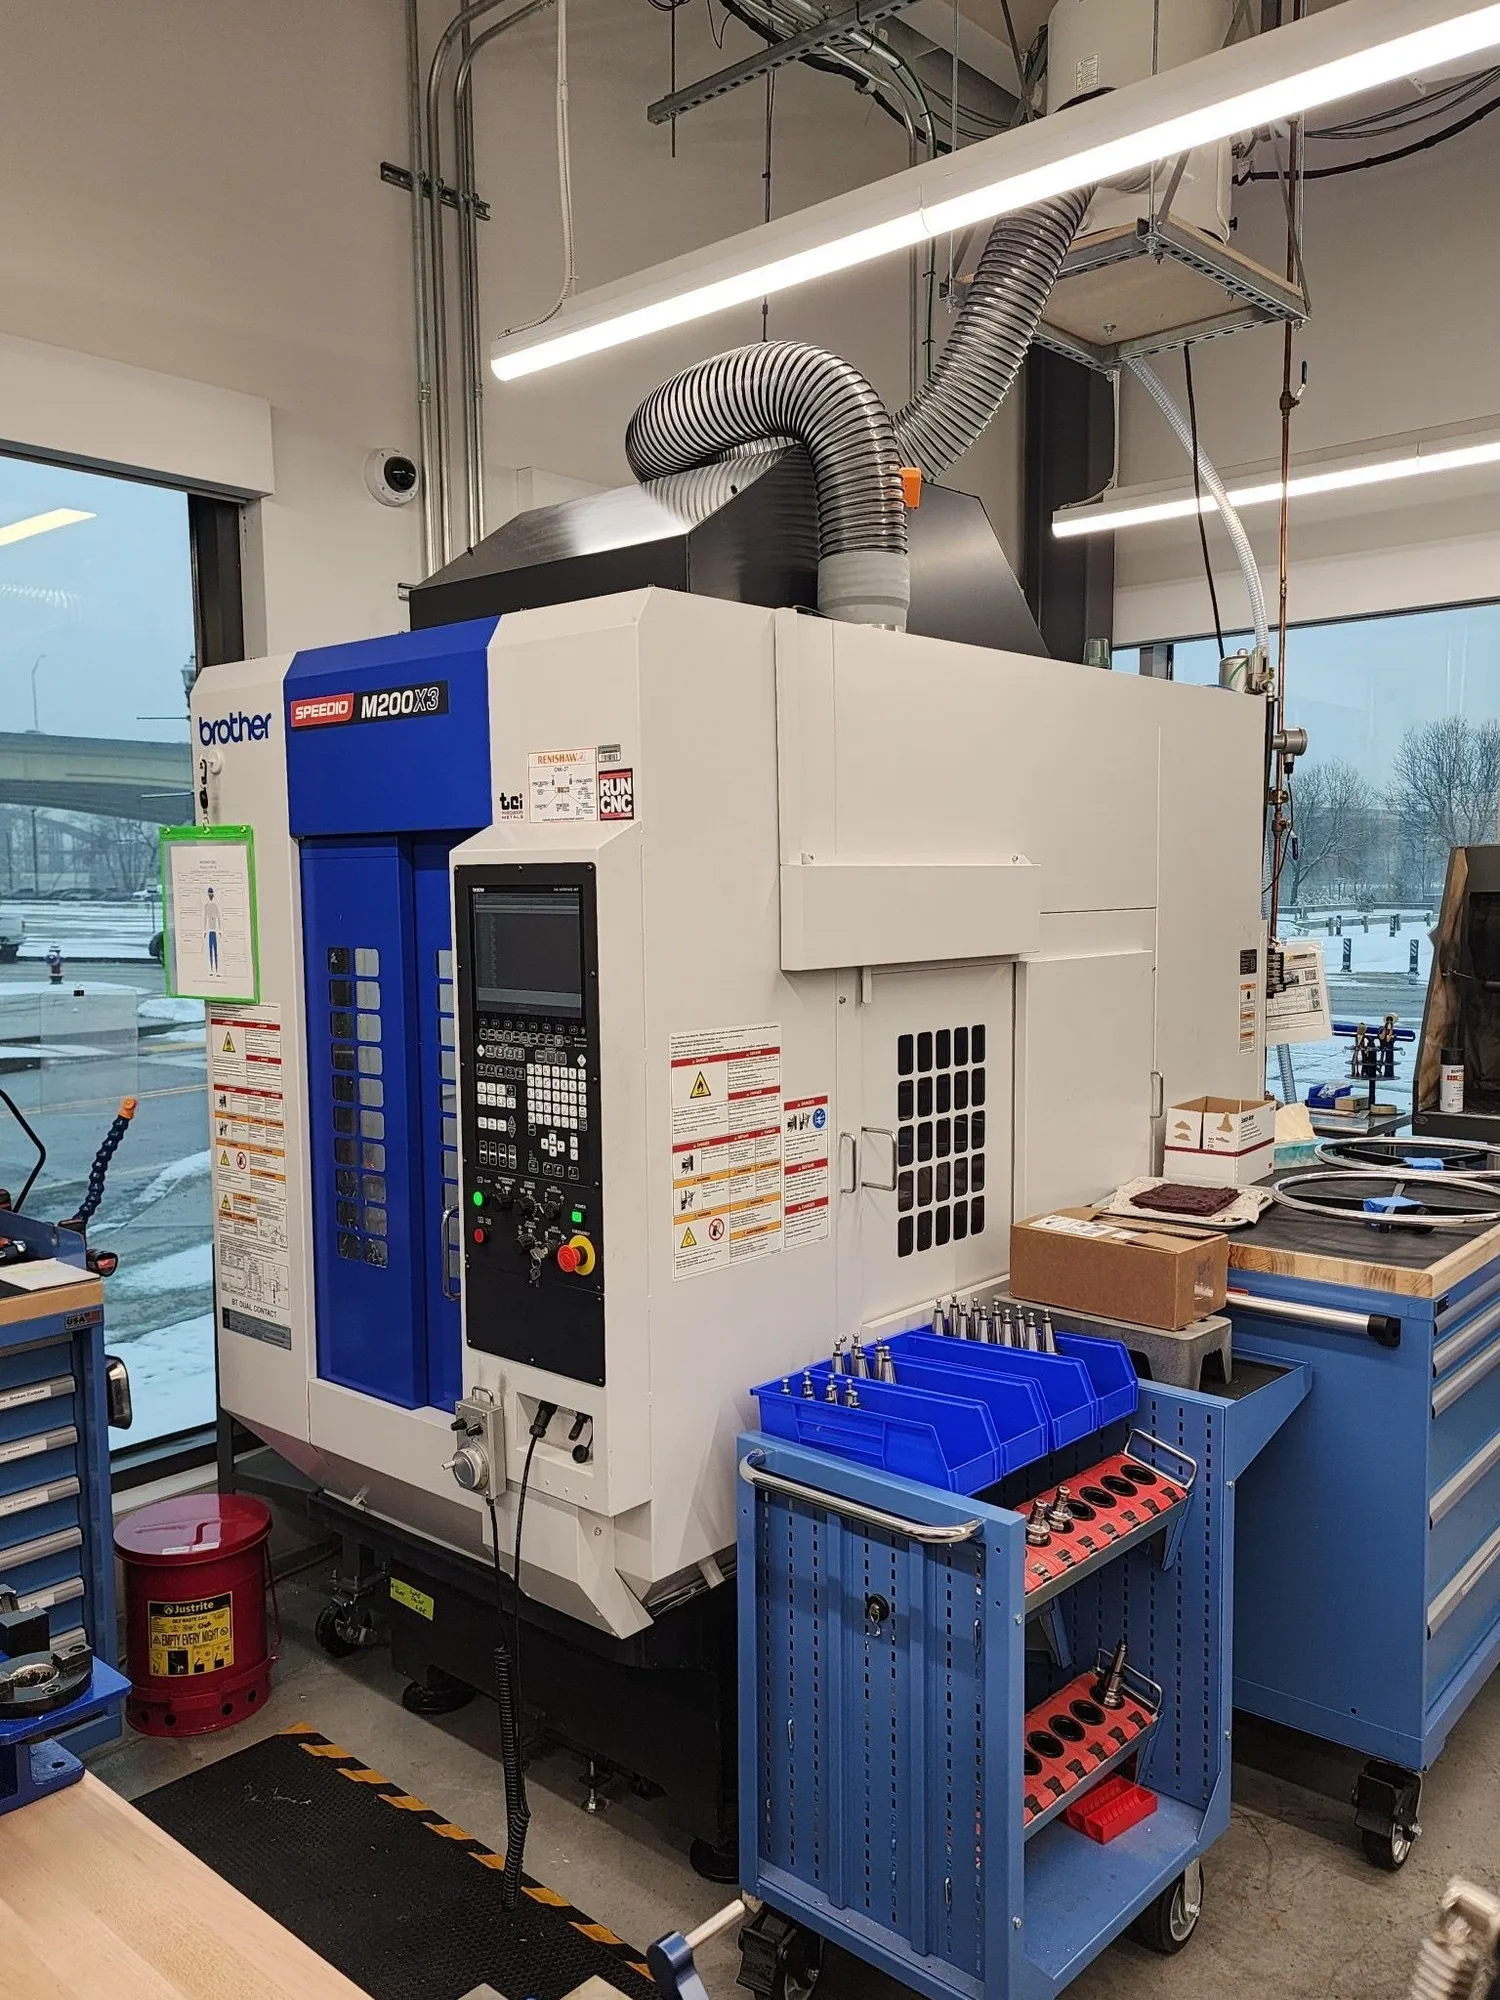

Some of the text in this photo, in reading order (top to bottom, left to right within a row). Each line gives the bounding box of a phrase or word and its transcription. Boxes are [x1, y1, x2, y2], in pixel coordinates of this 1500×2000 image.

[295, 687, 440, 720] SPEEDIO M200X3
[199, 711, 272, 746] brother
[538, 752, 577, 764] RENISHAW
[600, 778, 632, 796] RUN
[500, 792, 523, 810] tci
[600, 795, 632, 813] CNC
[239, 1300, 253, 1311] DUAL
[253, 1305, 277, 1318] CONTACT
[66, 1316, 86, 1325] USA
[174, 1602, 214, 1614] Justrite
[162, 1634, 180, 1646] EMPTY
[182, 1631, 200, 1646] EVERY
[202, 1628, 219, 1642] NIGHT
